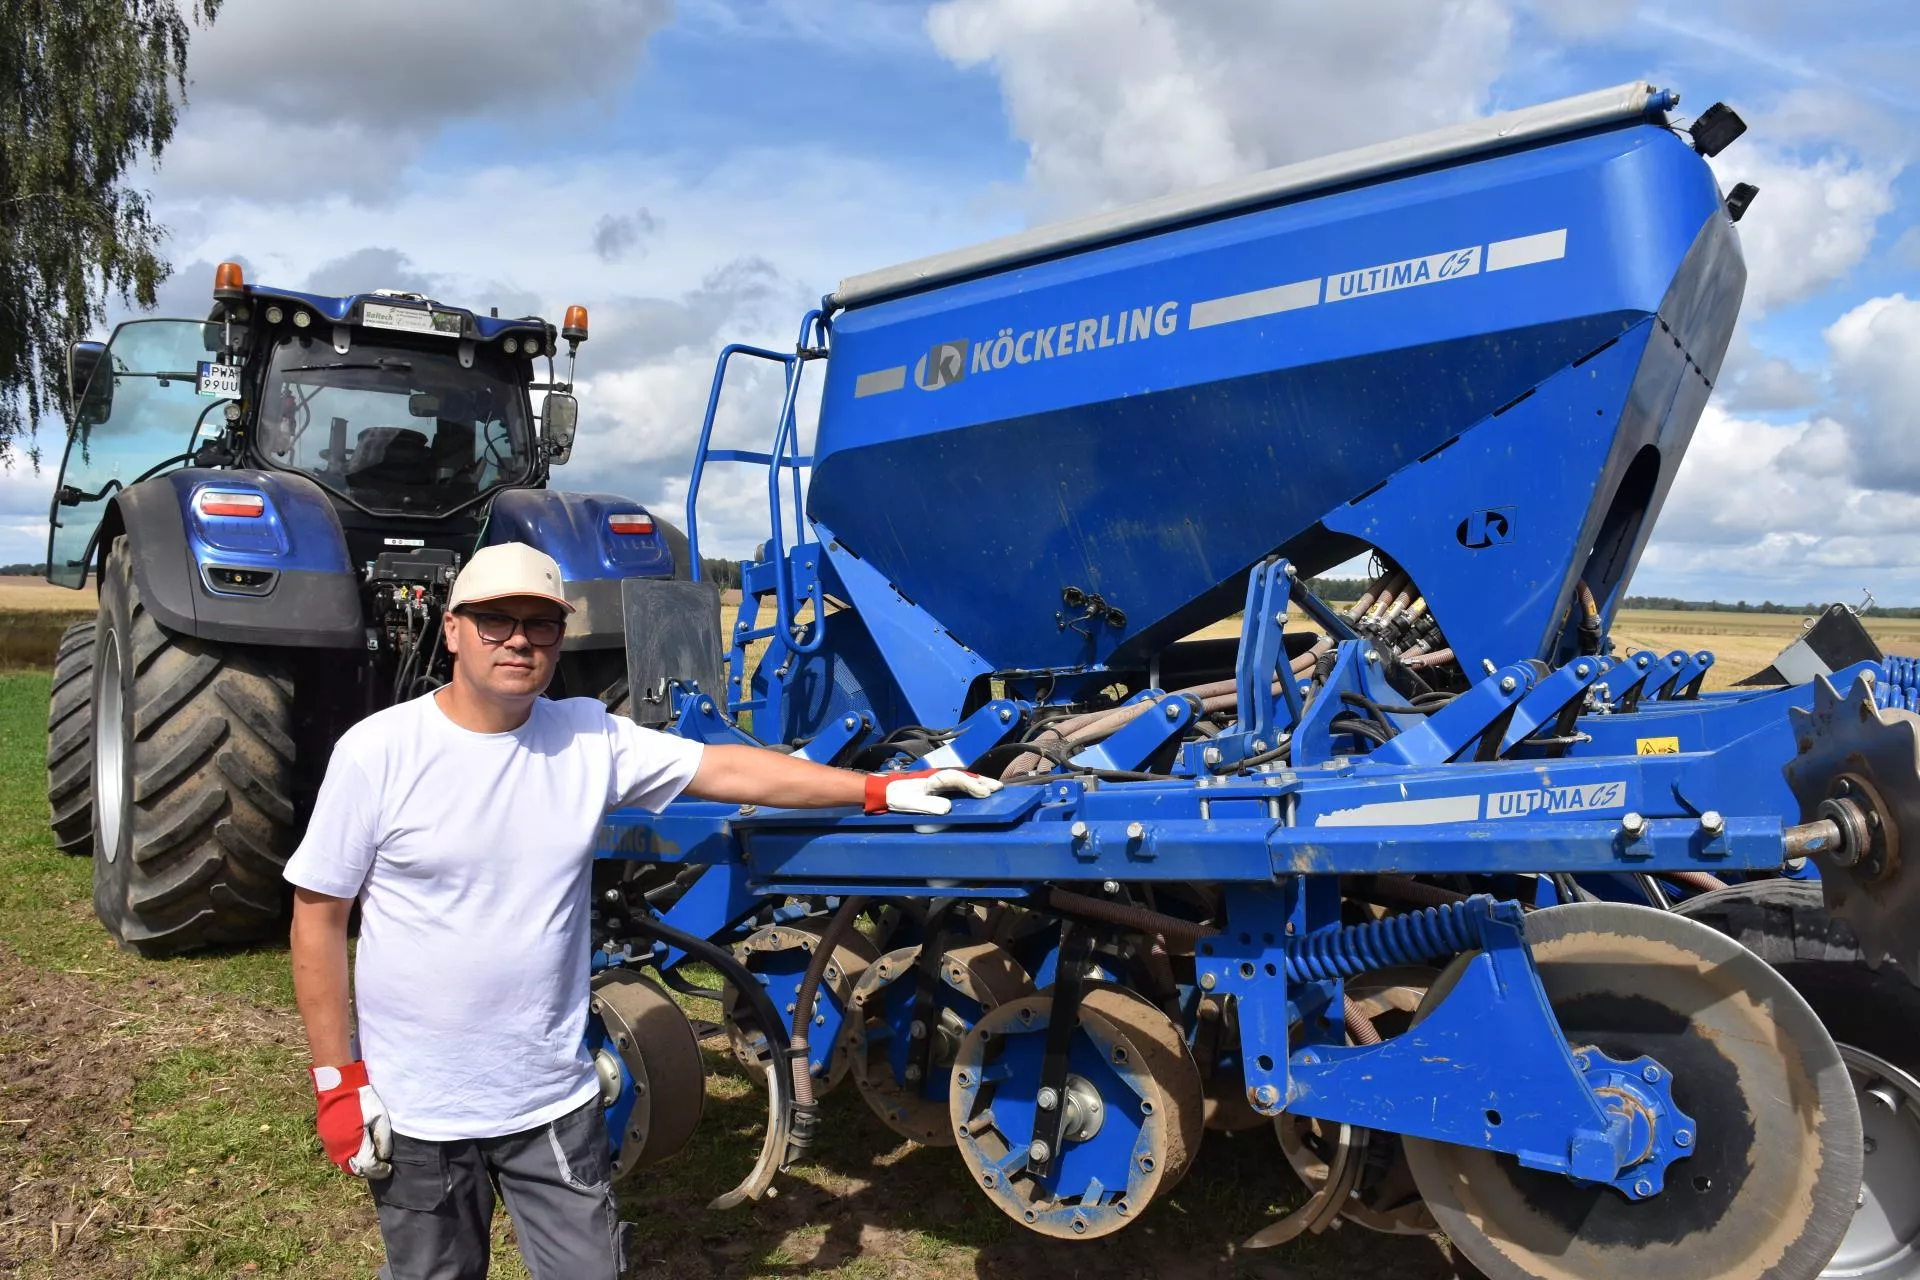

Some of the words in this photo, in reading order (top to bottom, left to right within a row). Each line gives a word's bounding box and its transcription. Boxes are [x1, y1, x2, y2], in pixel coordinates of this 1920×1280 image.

[1339, 260, 1430, 297] ULTIMA
[1438, 249, 1474, 278] CS
[970, 300, 1179, 374] KÖCKERLING
[204, 379, 238, 392] 99UU
[211, 366, 235, 378] PWA
[1499, 788, 1584, 815] ULTIMA
[1589, 784, 1620, 807] CS
